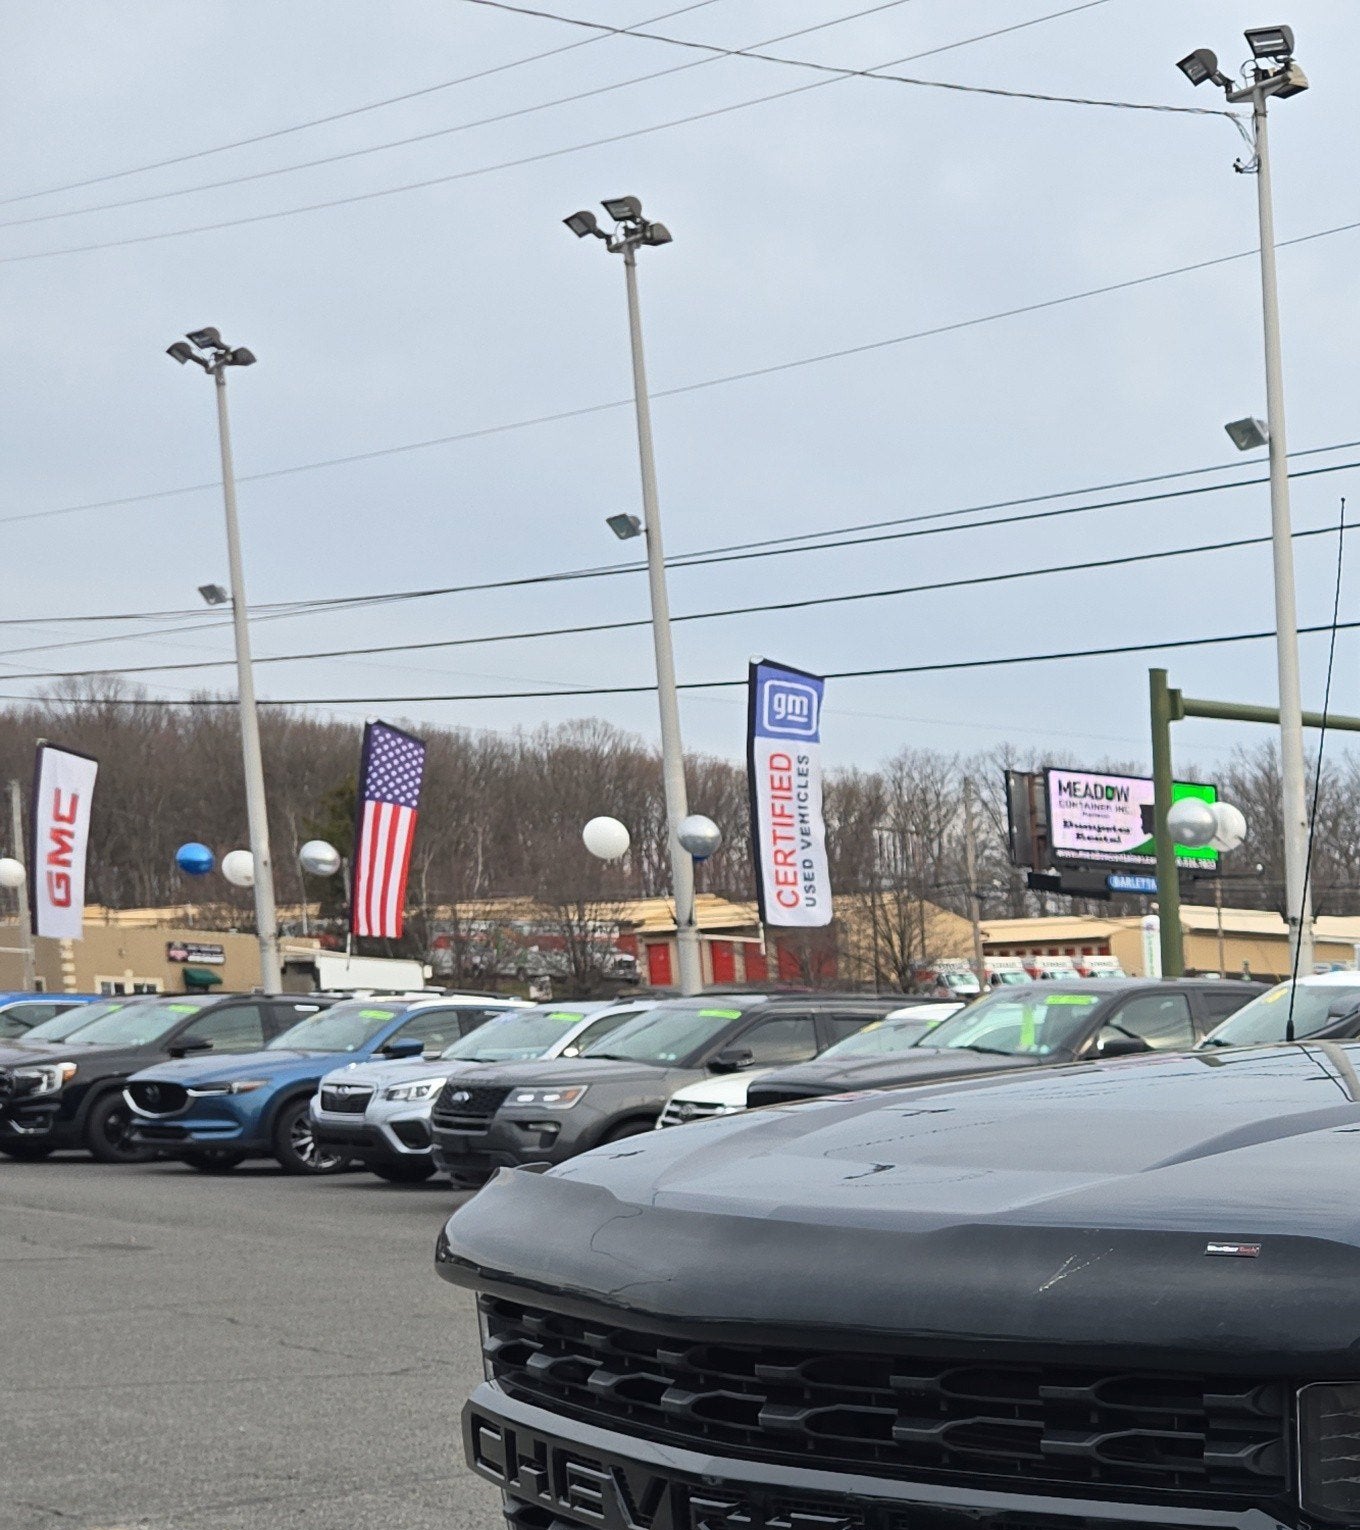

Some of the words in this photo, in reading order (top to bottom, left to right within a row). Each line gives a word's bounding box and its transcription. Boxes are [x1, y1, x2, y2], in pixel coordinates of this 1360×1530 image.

[773, 692, 809, 723] gm
[796, 754, 813, 851] VEHICLES
[1058, 779, 1130, 802] MEADOW
[47, 787, 80, 908] GMC
[769, 752, 801, 909] CERTIFIED
[801, 858, 817, 908] USED
